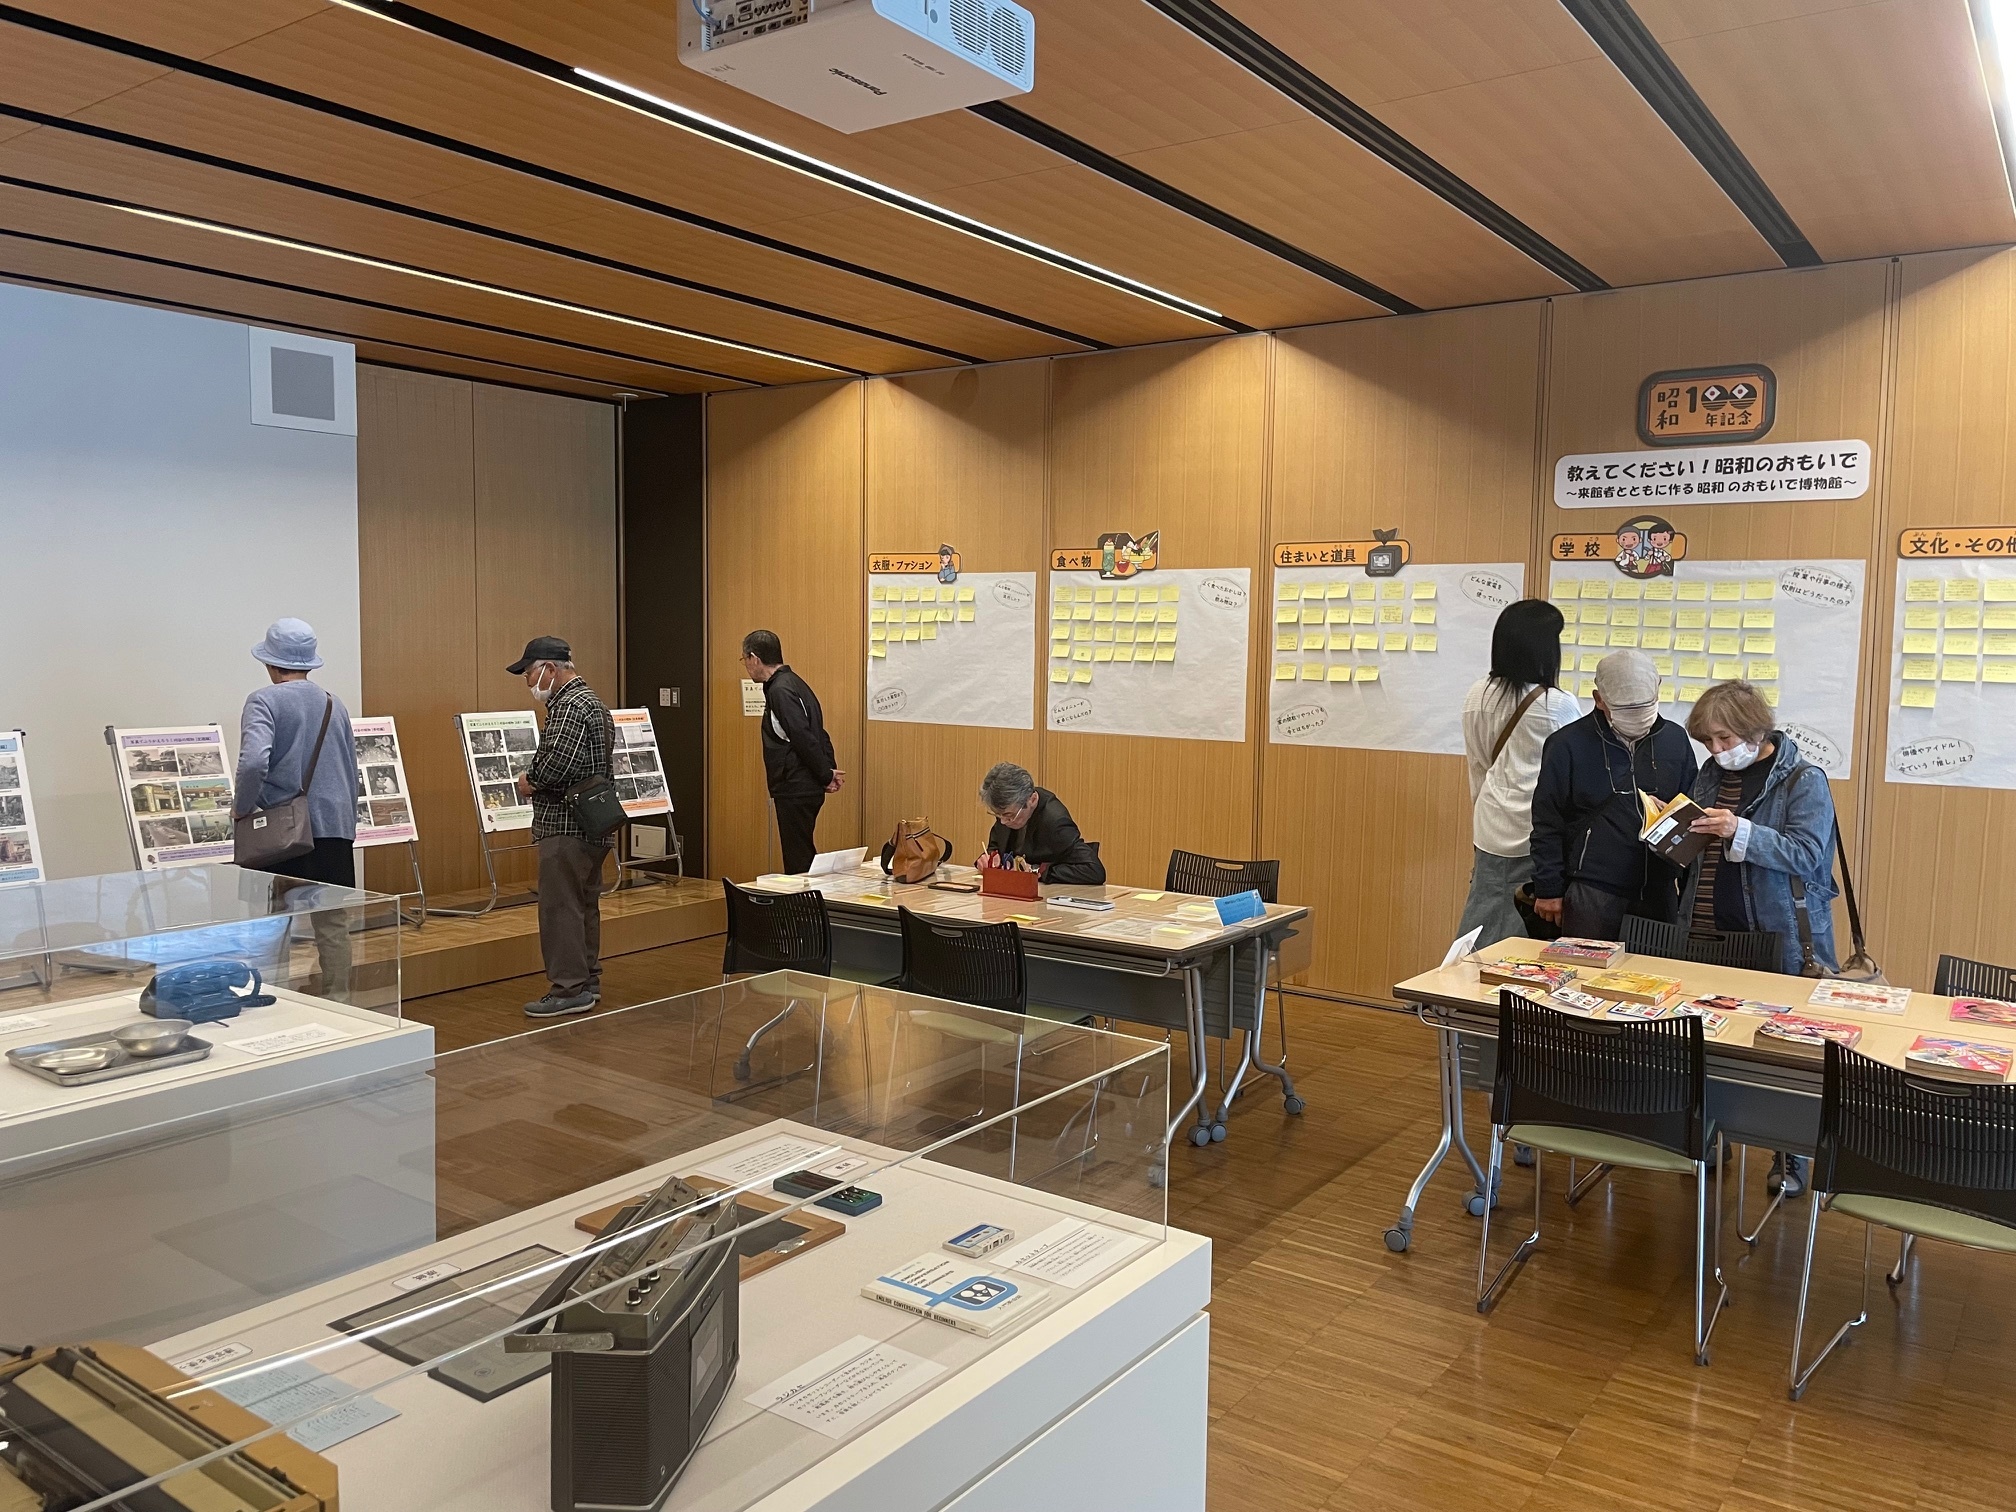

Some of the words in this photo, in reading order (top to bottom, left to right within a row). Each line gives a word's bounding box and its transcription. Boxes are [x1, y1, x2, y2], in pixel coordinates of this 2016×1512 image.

[829, 67, 887, 96] Panasonic
[1655, 387, 1680, 430] 昭和
[1705, 410, 1753, 428] 年記念
[1567, 451, 1859, 483] 教えてください！昭和のおもいで
[1279, 548, 1356, 564] 住まいと道具
[1559, 541, 1601, 558] 学校
[1056, 555, 1092, 568] 食べ物
[1015, 1243, 1049, 1265] カセットテープ
[875, 1294, 893, 1306] ENGLISH
[893, 1300, 923, 1316] CONVERSATION
[924, 1309, 932, 1319] FOR
[933, 1314, 957, 1327] BEGINNERS
[775, 1383, 804, 1402] ラジカセ
